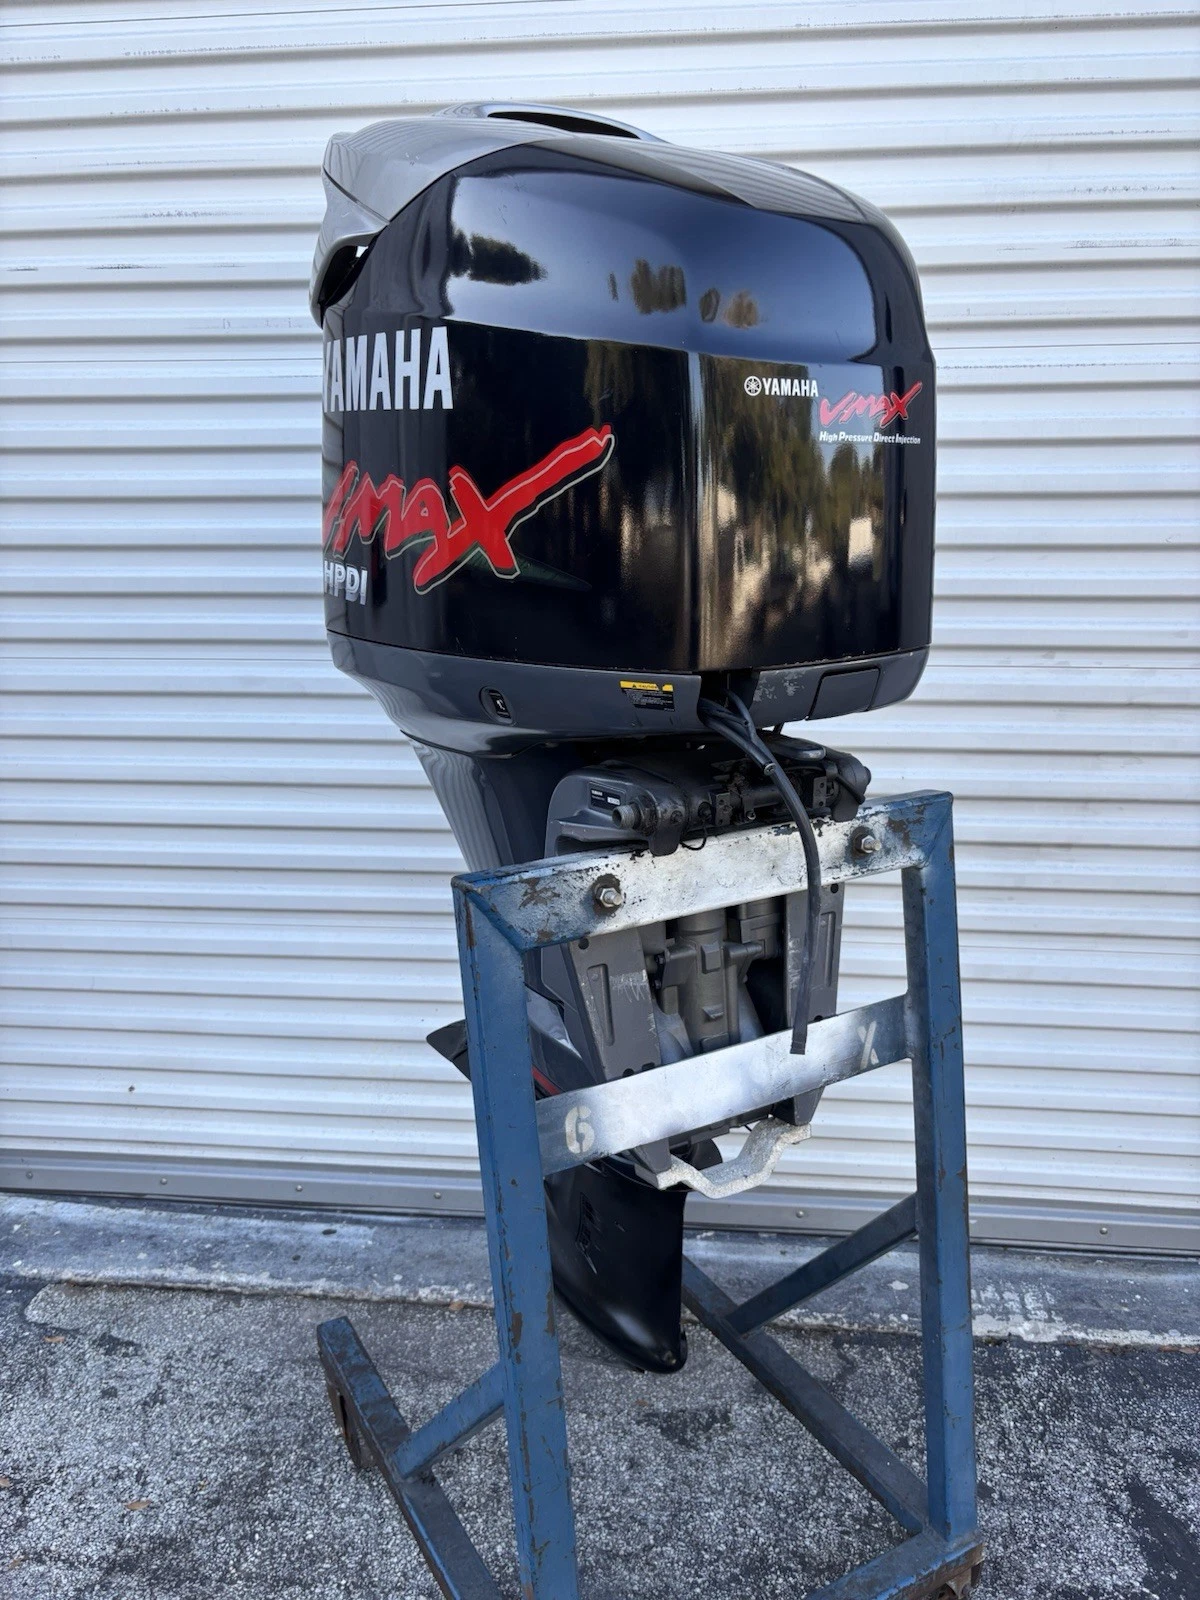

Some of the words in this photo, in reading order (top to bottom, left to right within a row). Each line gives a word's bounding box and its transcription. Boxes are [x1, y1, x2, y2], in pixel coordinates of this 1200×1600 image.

[763, 378, 818, 397] YAMAHA
[819, 431, 838, 443] High
[839, 432, 872, 443] Pressure
[873, 432, 895, 443] Direct
[895, 434, 920, 444] Injection
[324, 560, 368, 605] HPDI
[565, 1106, 595, 1154] 6
